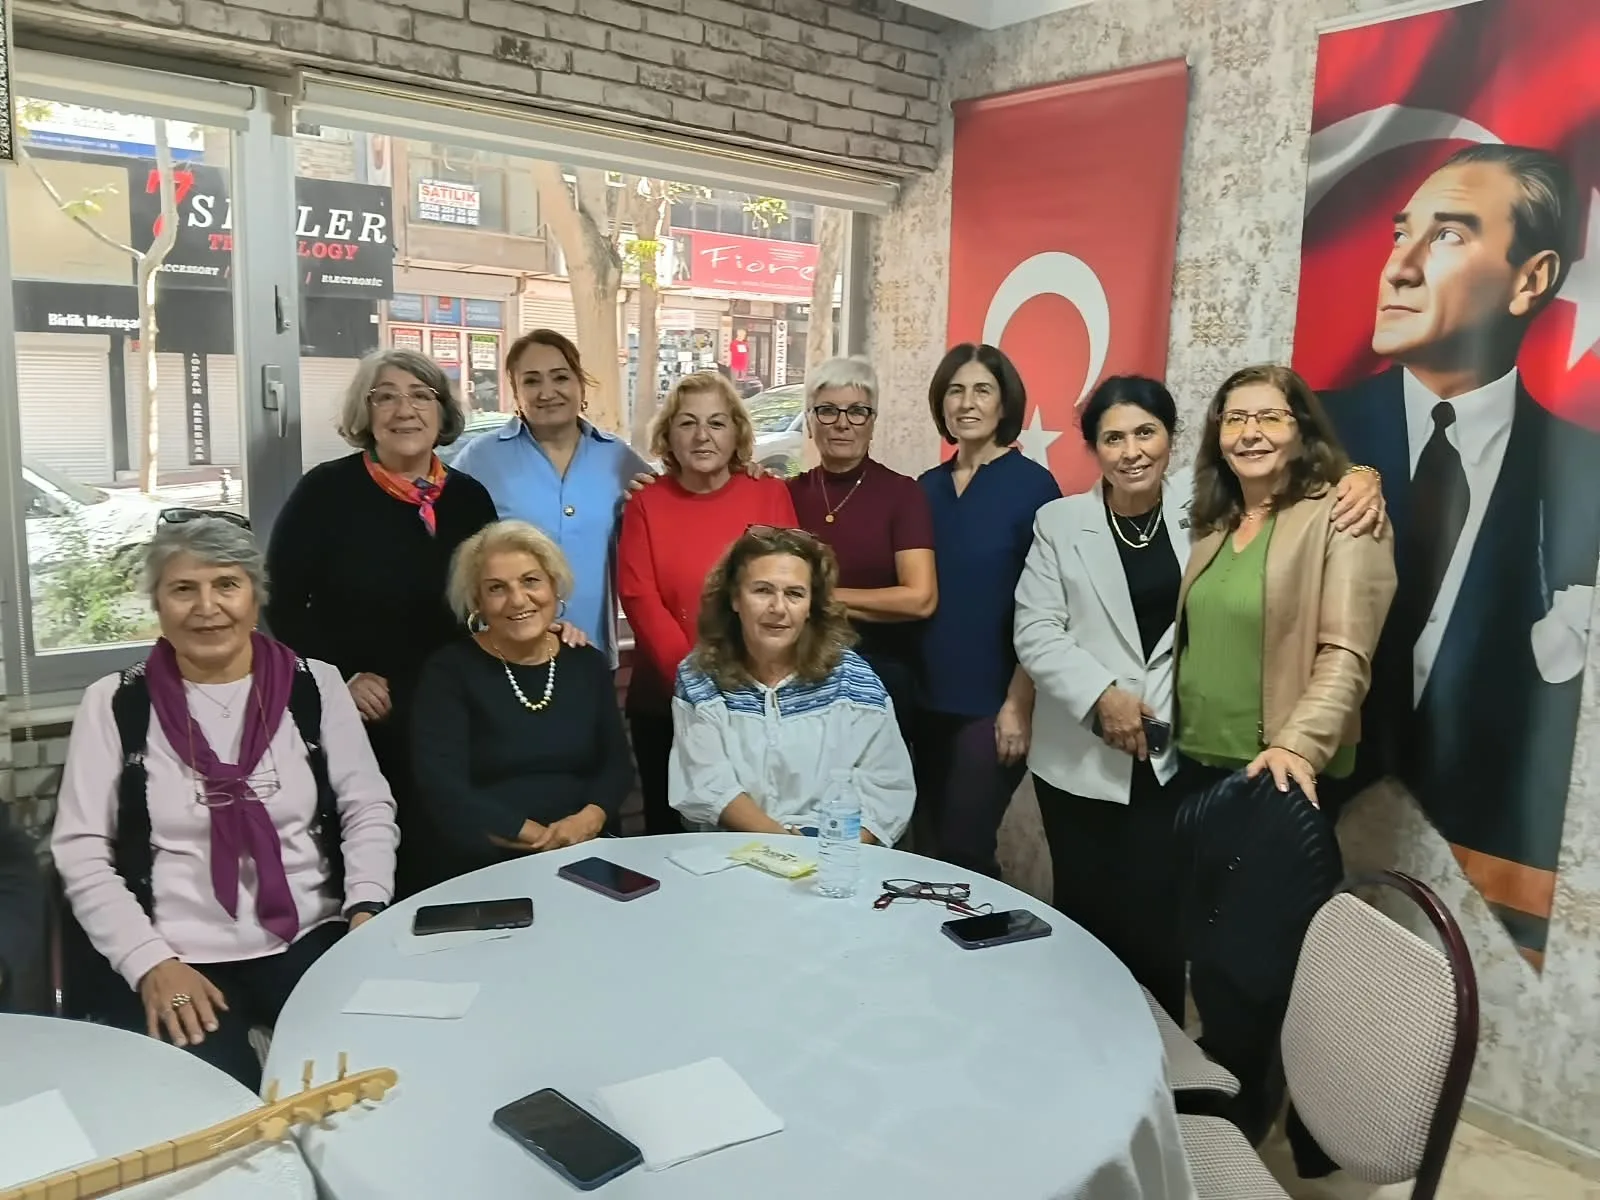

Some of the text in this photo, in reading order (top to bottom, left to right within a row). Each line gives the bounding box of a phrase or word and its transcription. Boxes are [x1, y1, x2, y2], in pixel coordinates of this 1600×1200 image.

[423, 185, 476, 202] SATILIK
[187, 194, 388, 244] SLER
[207, 232, 359, 261] TELOGY
[48, 312, 85, 327] Birlik
